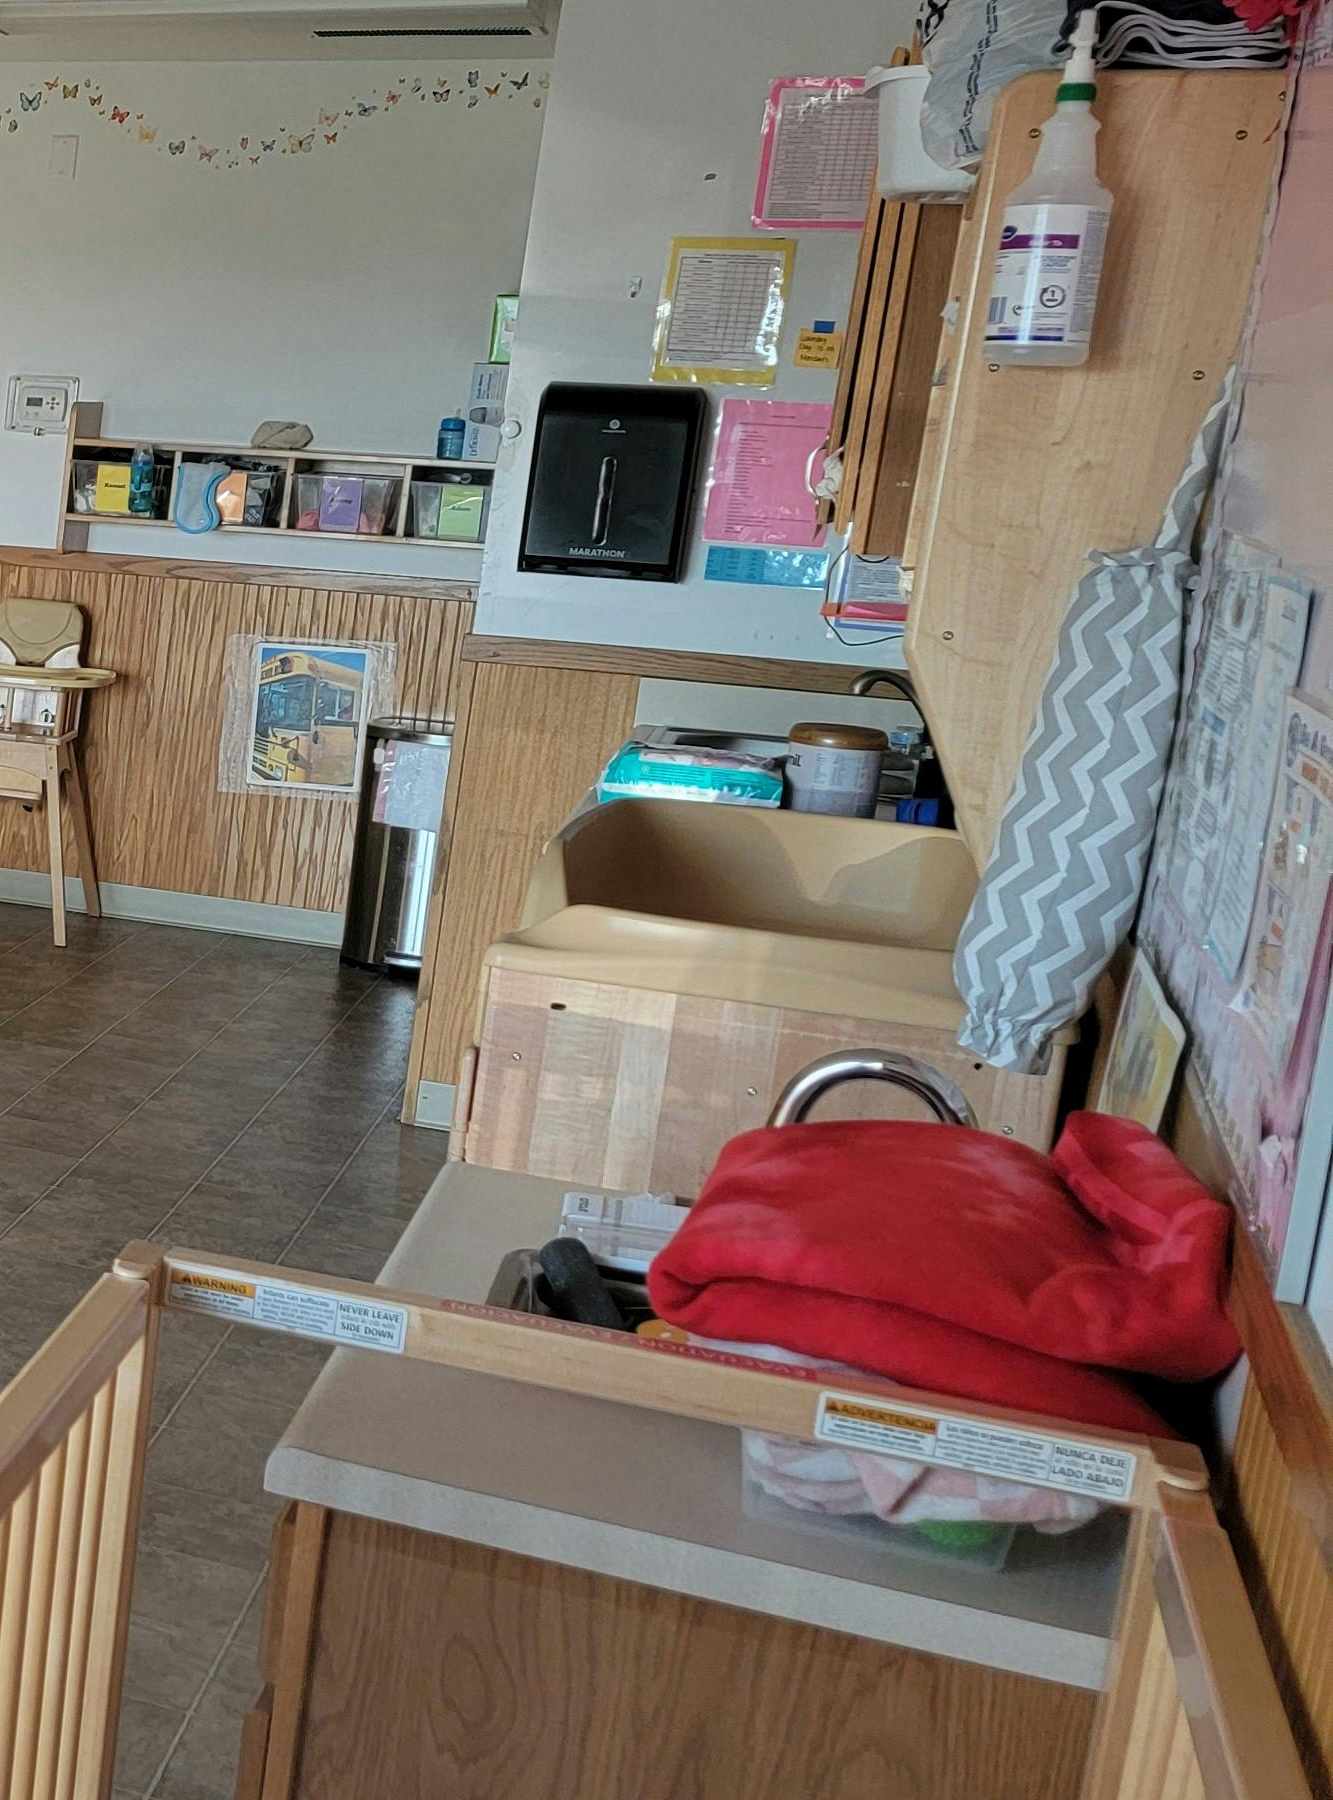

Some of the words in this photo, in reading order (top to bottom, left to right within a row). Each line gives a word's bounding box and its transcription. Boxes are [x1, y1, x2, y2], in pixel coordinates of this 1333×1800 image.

[799, 343, 811, 352] Day
[569, 548, 625, 558] MARATHON
[191, 1274, 247, 1294] WARNING
[339, 1303, 369, 1317] NEVER
[372, 1309, 400, 1323] LEAVE
[341, 1321, 361, 1333] SIDE
[364, 1326, 394, 1340] DOWN
[1055, 1446, 1097, 1463] NUNCA
[1100, 1454, 1127, 1469] DEJE
[1052, 1464, 1084, 1480] LADO
[1086, 1472, 1124, 1488] ABAJO
